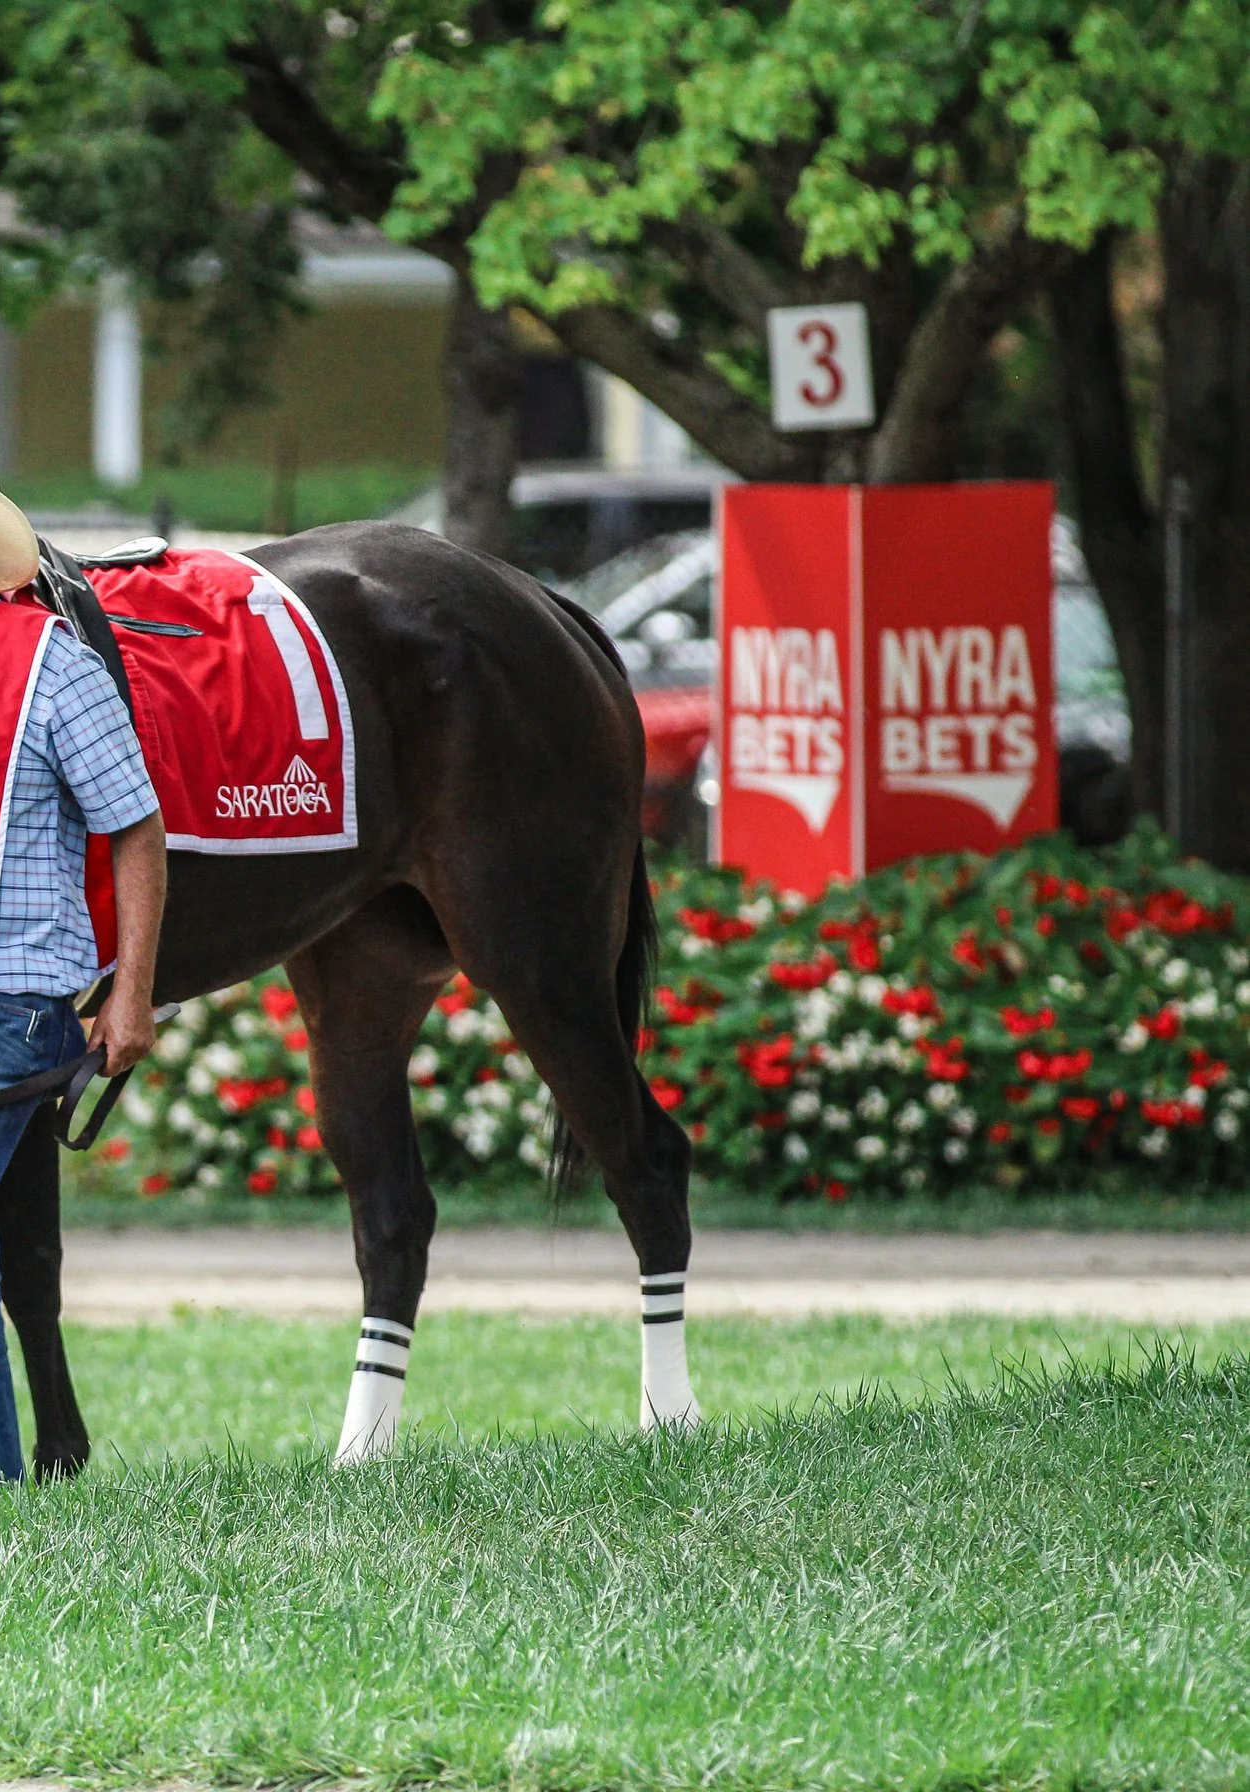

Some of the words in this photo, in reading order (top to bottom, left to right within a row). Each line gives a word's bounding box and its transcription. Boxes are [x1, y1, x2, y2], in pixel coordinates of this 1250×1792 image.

[795, 320, 844, 408] 3
[247, 575, 329, 741] 1
[730, 625, 843, 713] NYRA
[878, 624, 1038, 713] NYRA
[729, 713, 844, 772] BETS
[880, 713, 1039, 773] BETS
[214, 781, 332, 819] SARATOGA
